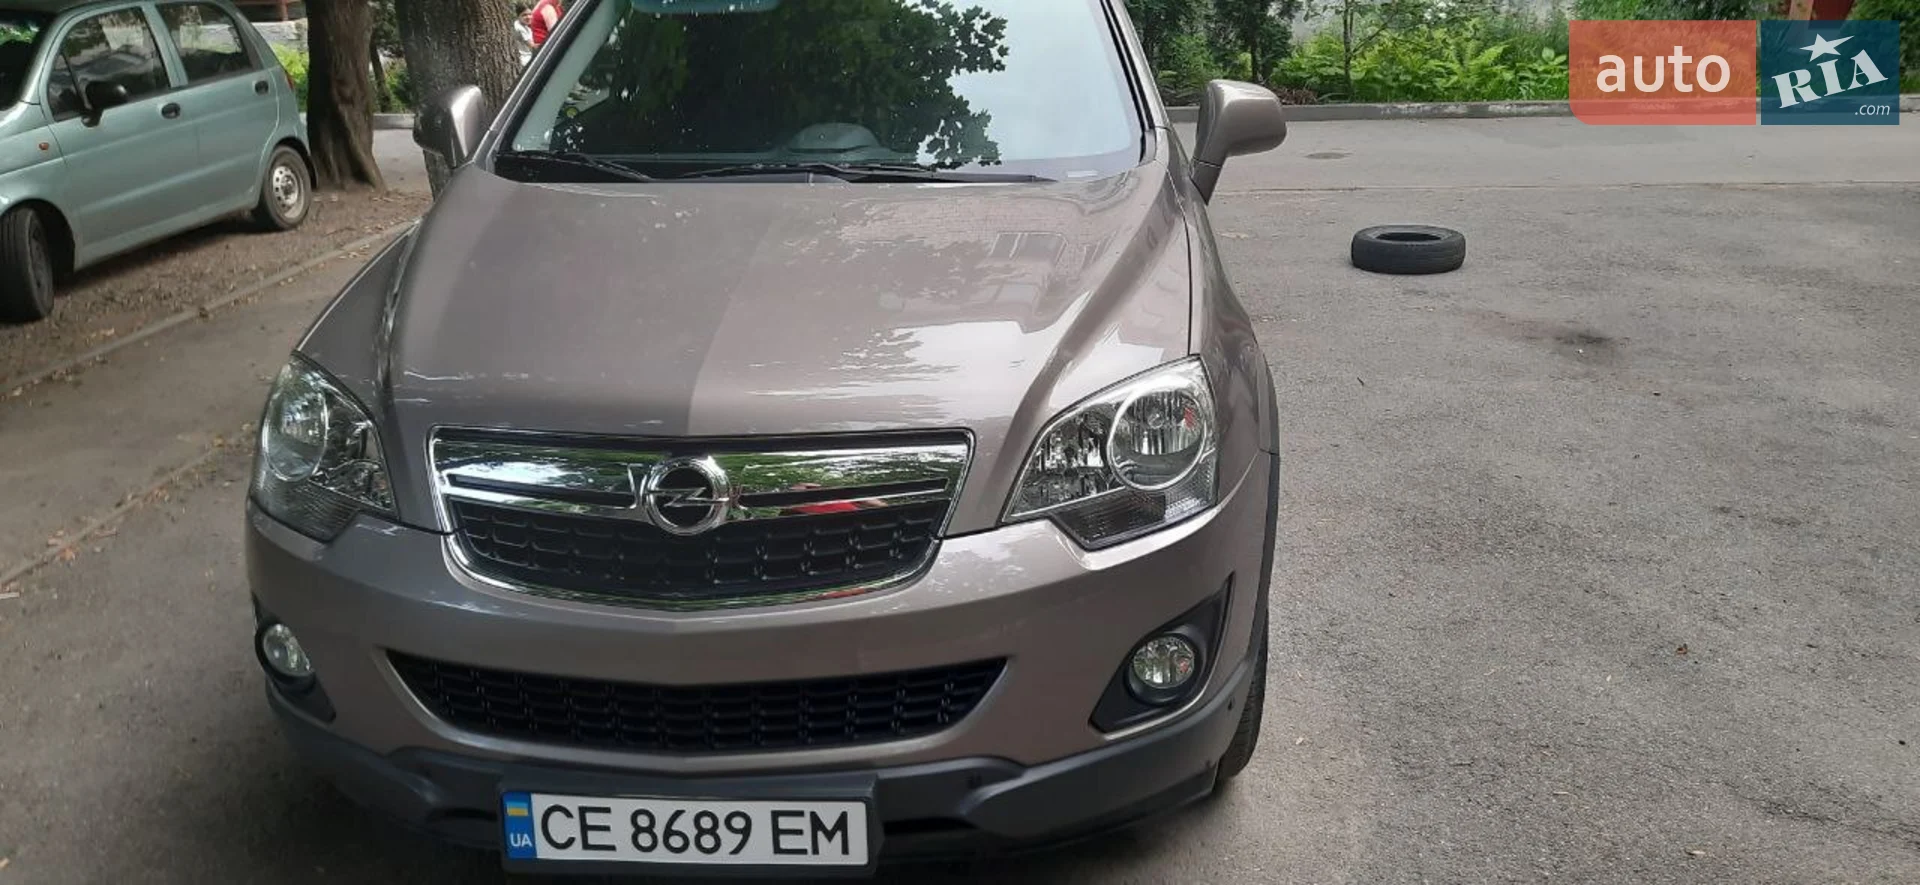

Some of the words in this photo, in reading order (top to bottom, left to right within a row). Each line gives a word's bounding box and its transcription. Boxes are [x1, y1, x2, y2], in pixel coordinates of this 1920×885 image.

[510, 833, 532, 847] UA
[540, 804, 617, 852] CE
[630, 808, 752, 855] 8689
[770, 810, 850, 856] EM
